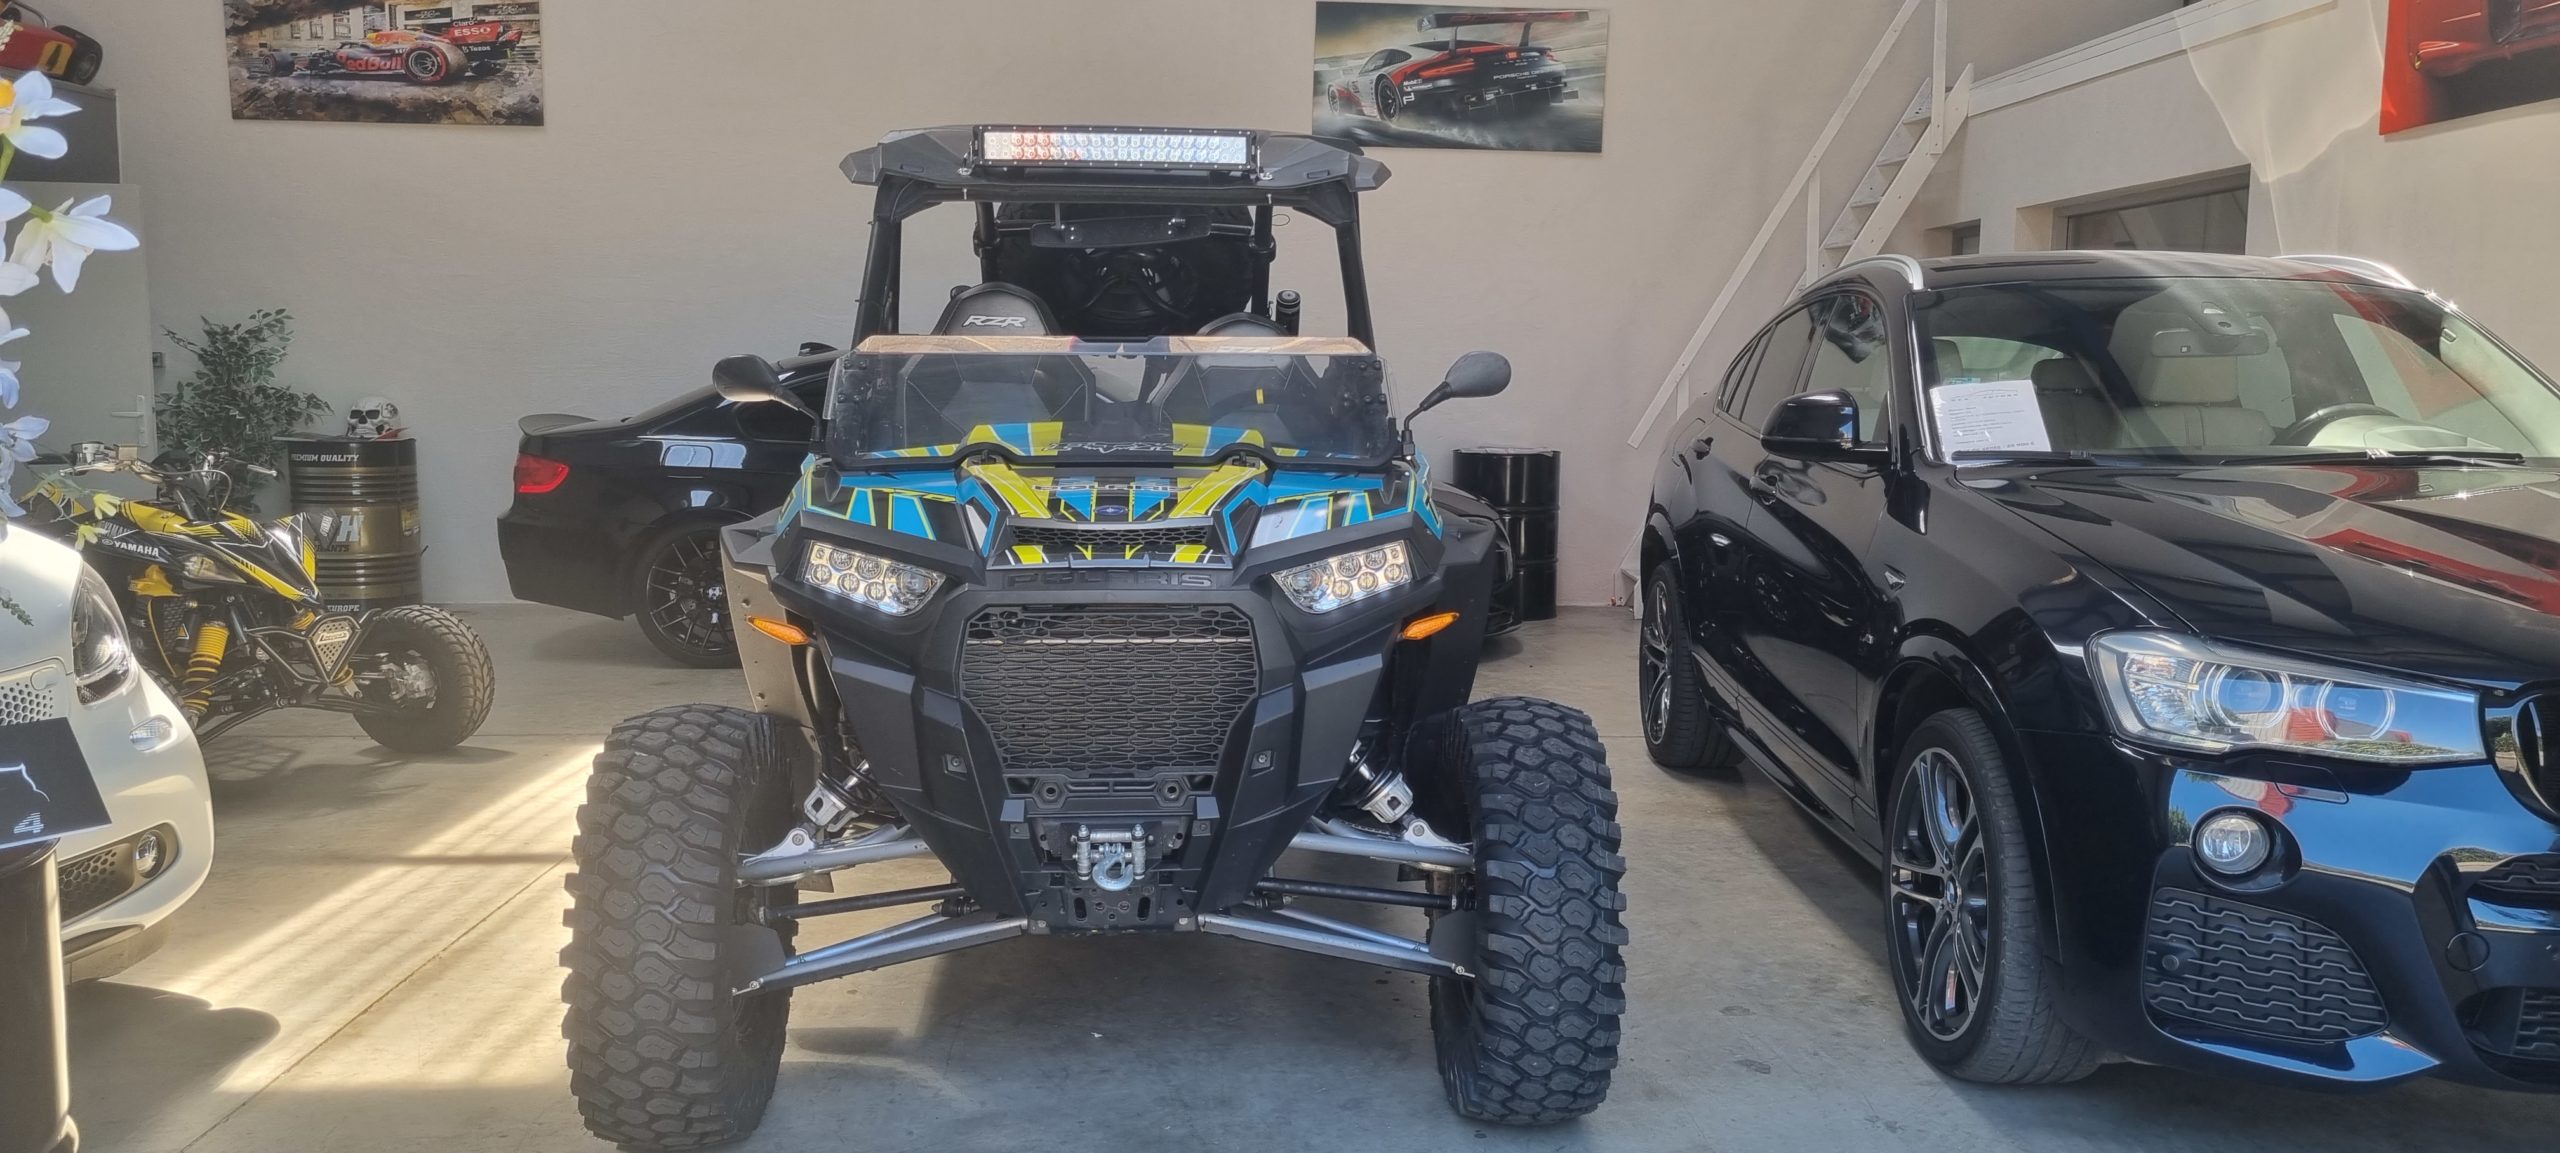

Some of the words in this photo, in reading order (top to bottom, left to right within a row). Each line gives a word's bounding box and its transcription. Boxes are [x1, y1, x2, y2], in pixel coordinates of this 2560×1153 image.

[454, 26, 491, 37] ESSO
[962, 315, 1026, 328] RZR
[320, 454, 359, 462] QUALITY
[114, 541, 160, 557] YAMAHA
[1007, 569, 1213, 588] POLARIS
[14, 812, 44, 834] 4
